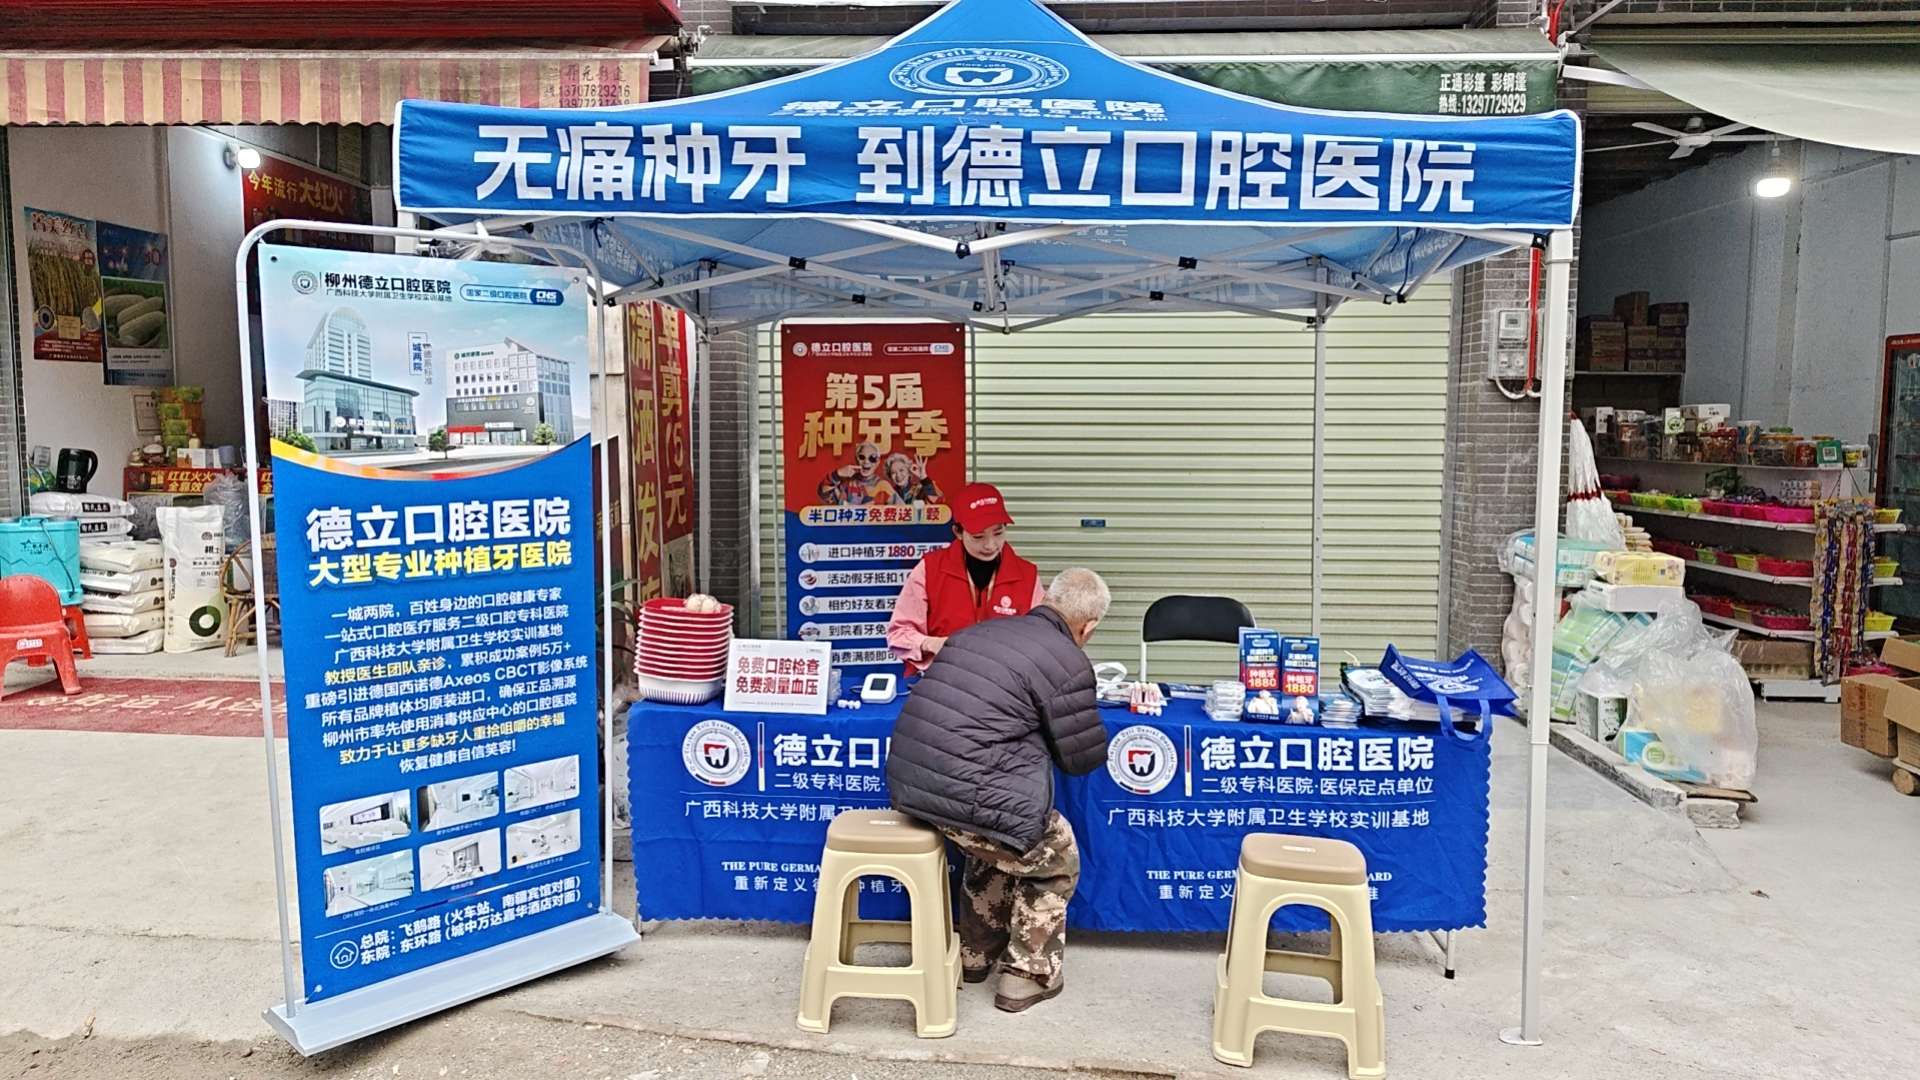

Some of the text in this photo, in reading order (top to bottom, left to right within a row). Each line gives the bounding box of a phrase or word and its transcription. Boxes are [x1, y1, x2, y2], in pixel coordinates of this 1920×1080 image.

[473, 122, 1476, 212] 无痛种牙 到德立口腔医院
[324, 271, 452, 294] 柳州德立口腔医院
[825, 372, 924, 409] 第5届
[799, 409, 951, 458] 种牙季
[168, 481, 204, 493] 全靠效
[305, 497, 571, 552] 德立口腔医院
[308, 540, 572, 587] 大型专业种植牙医院
[828, 572, 911, 586] 活动假牙抵扣1
[324, 604, 569, 642] 一站式口腔医疗服务二级口腔专科医院
[334, 624, 563, 664] 广西科技大学附属卫生学校实训基地
[737, 655, 820, 676] 免费口腔检查
[735, 676, 819, 696] 免费测量血压
[1248, 678, 1277, 688] 1880
[1285, 684, 1315, 693] 1880
[322, 692, 577, 748] 柳州市率先使用消毒供应中心的口腔医院
[340, 712, 566, 766] 致力于让更多缺牙人重拾咀嚼的幸福
[773, 733, 891, 768] 德立口
[1201, 736, 1434, 771] 德立口腔医院
[1201, 776, 1434, 797] 二级专科医院·医保定点单位
[685, 800, 892, 821] 广西科技大学附属
[1108, 807, 1430, 830] 广西科技大学附属卫生学校实训基地
[721, 861, 746, 872] THE
[749, 861, 778, 873] PURE
[1146, 870, 1170, 880] THE
[1173, 870, 1205, 880] PURE
[1159, 884, 1234, 900] 重新定义
